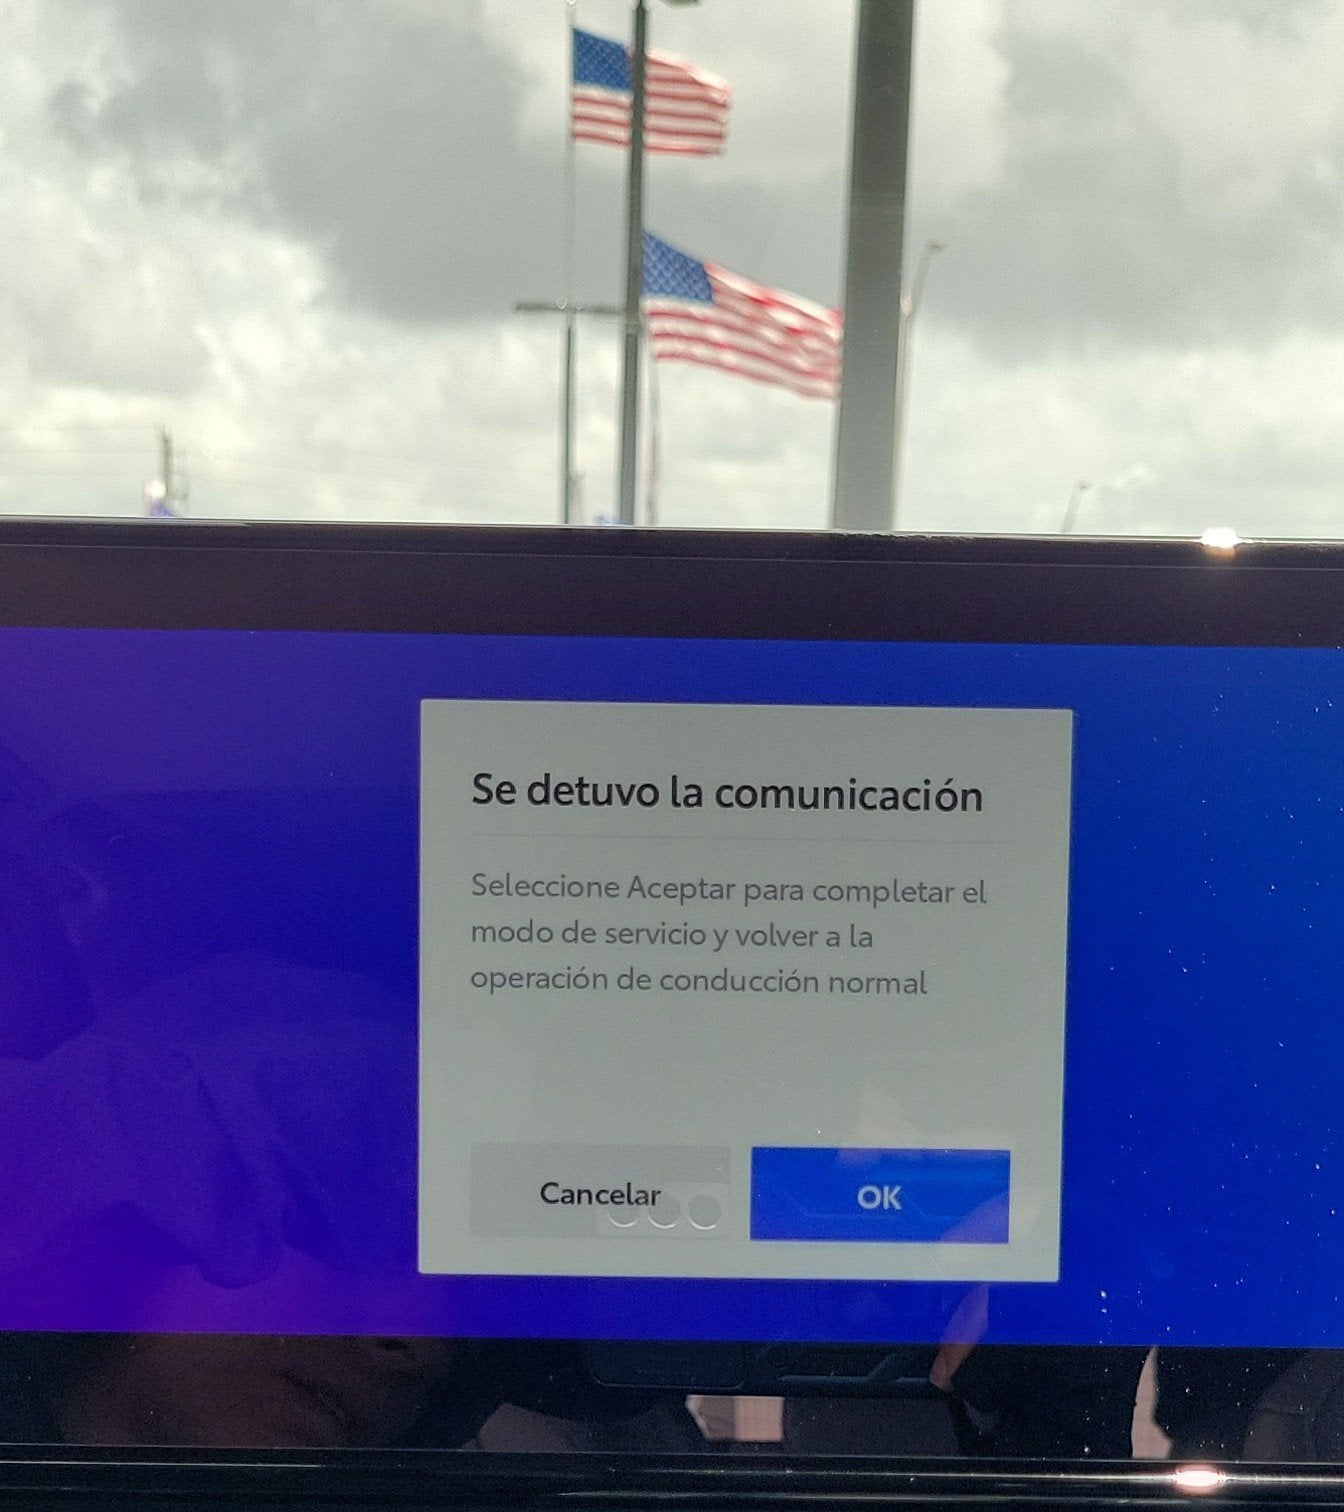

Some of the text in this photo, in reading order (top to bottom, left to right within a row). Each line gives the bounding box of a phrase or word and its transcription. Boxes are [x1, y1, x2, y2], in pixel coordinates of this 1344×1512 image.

[473, 774, 983, 813] Se detuvo la comunicación
[471, 872, 987, 909] Seleccione Aceptar para completar el
[471, 920, 873, 953] modo de servicio y volver a la
[470, 966, 927, 995] operación de conducción normal
[540, 1181, 662, 1207] Cancelar
[857, 1186, 902, 1210] OK
